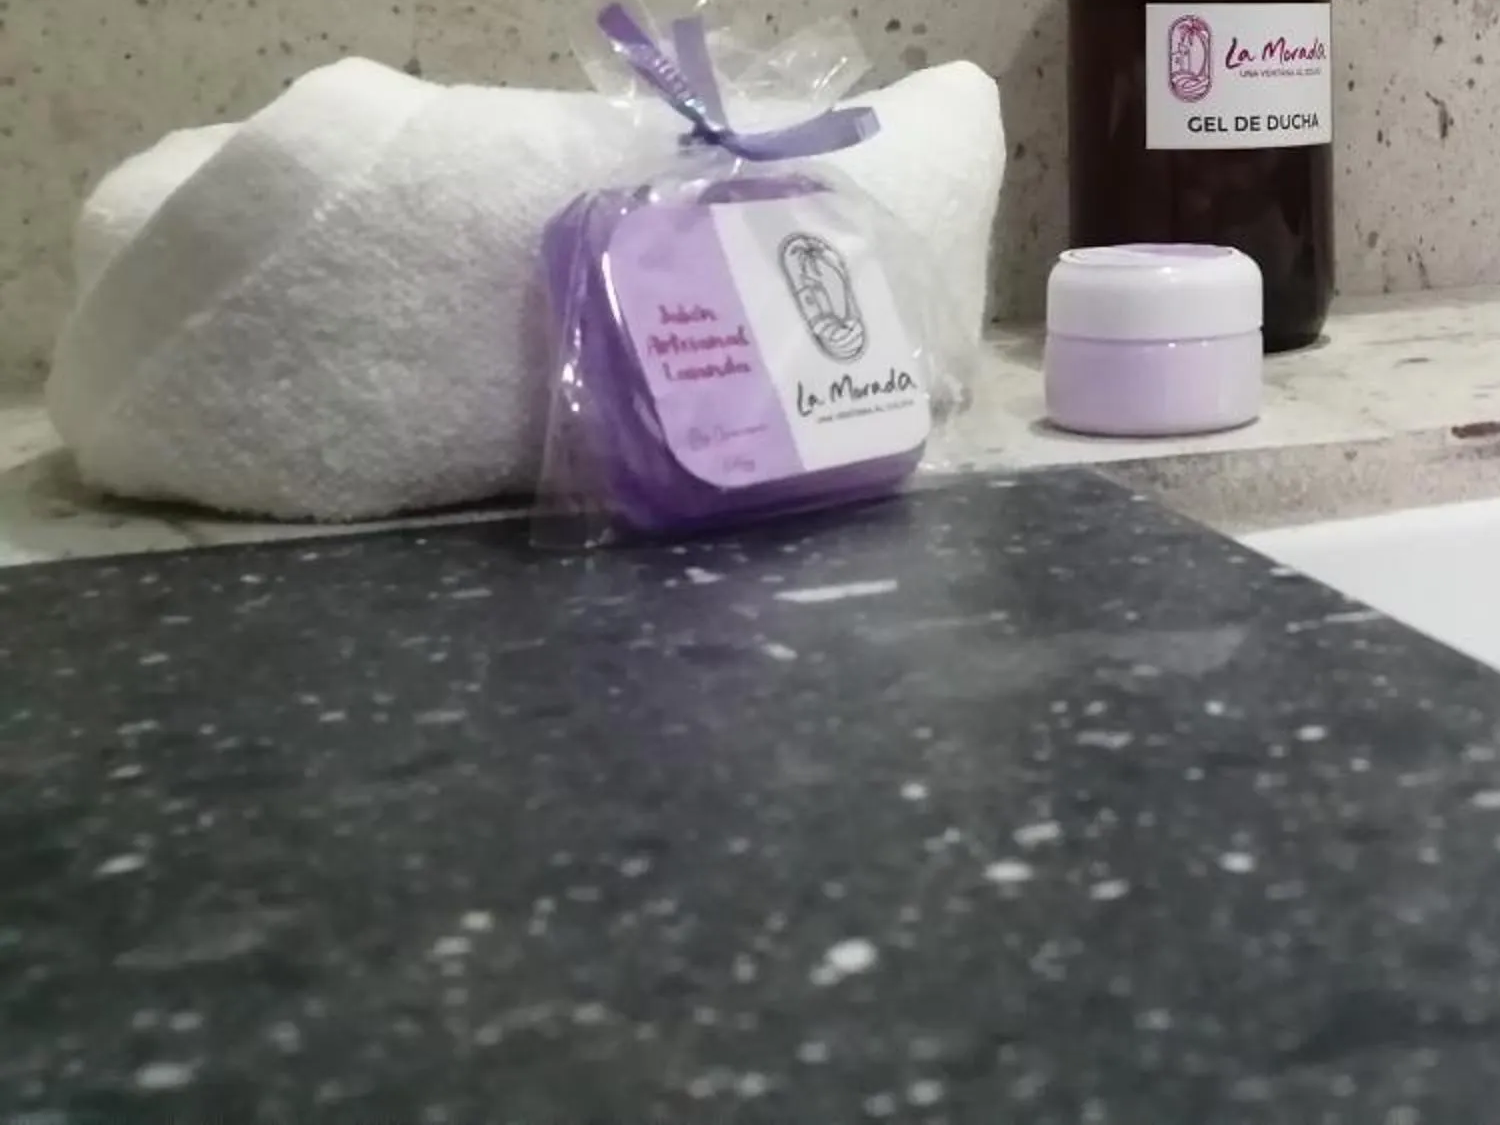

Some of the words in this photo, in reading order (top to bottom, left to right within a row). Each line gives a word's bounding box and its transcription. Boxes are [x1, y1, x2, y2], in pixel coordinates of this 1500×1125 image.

[1225, 37, 1254, 69] La
[1262, 36, 1326, 64] Morada
[1187, 116, 1228, 132] GEL
[1234, 115, 1261, 132] DE
[1267, 112, 1319, 130] DUCHA
[797, 380, 825, 417] La
[829, 367, 917, 403] Morada
